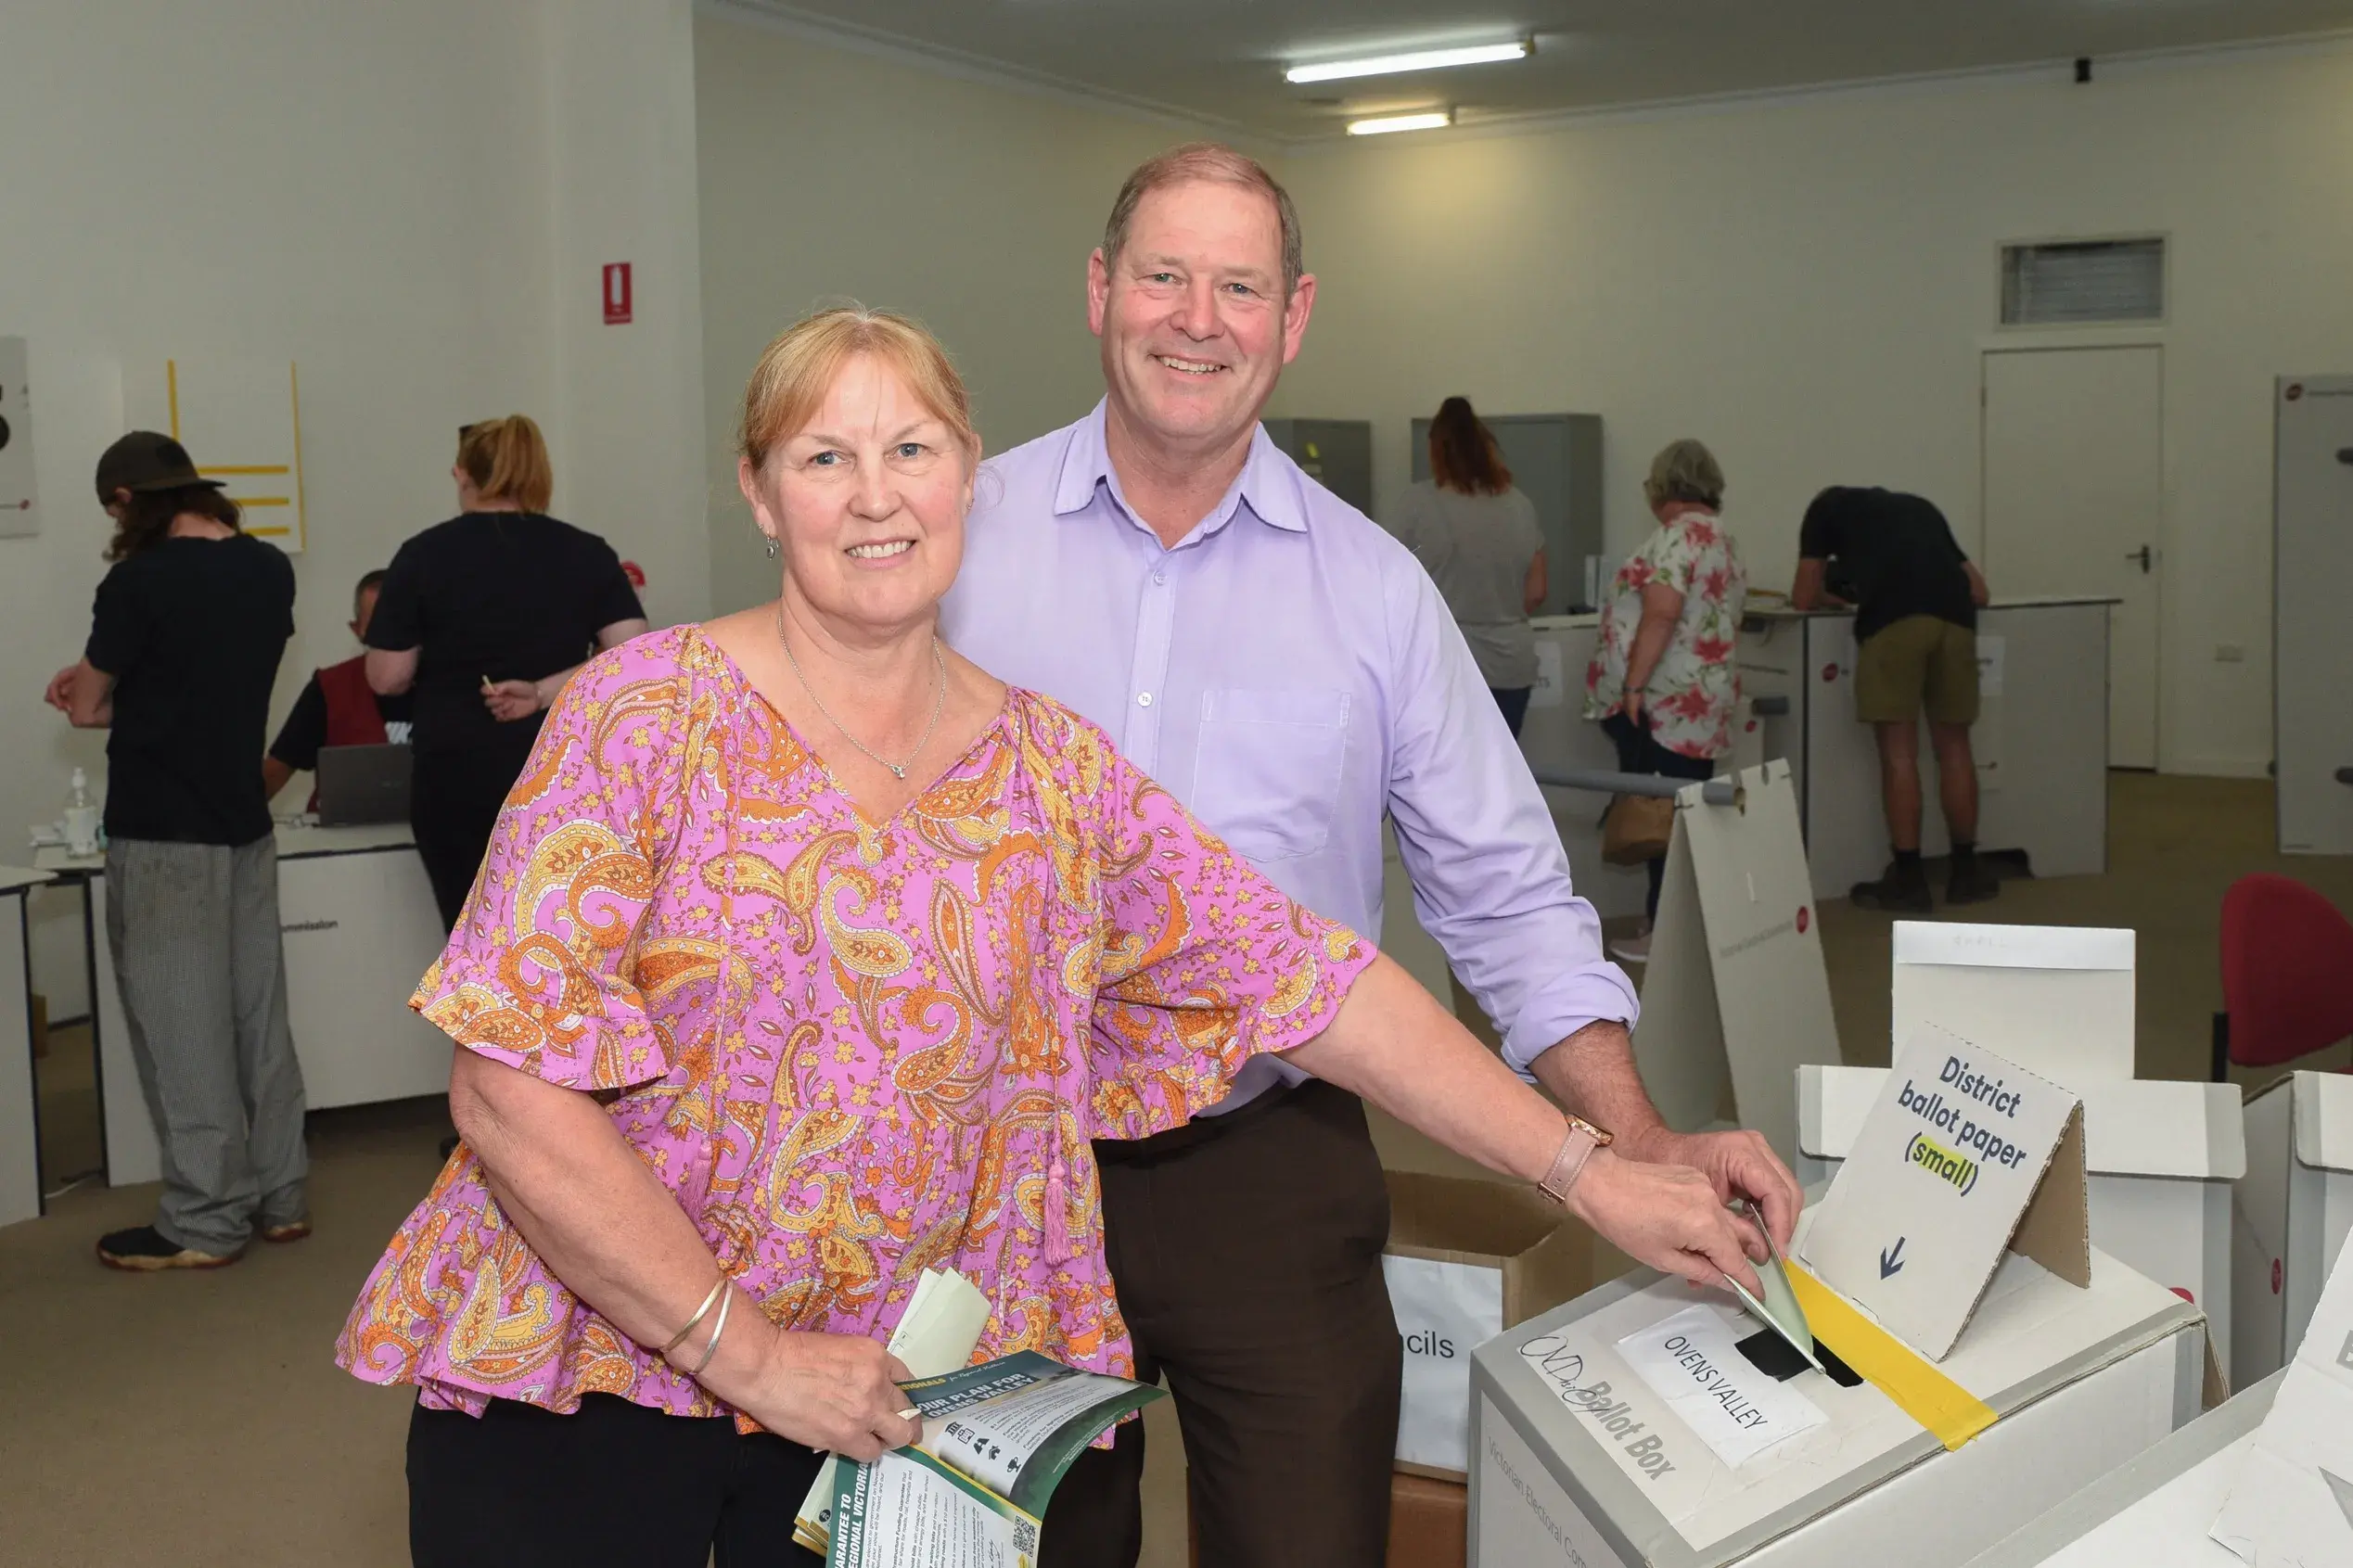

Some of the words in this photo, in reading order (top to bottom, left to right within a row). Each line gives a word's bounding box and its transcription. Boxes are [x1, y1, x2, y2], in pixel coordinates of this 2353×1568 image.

[1939, 1055, 2021, 1118] District
[1898, 1079, 1961, 1134] ballot
[1954, 1121, 2027, 1169] paper
[1905, 1131, 1979, 1197] (small)
[1400, 1330, 1454, 1358] cils
[916, 1398, 950, 1412] OUR
[949, 1384, 992, 1401] PLAN
[991, 1373, 1026, 1388] FOR
[927, 1398, 978, 1418] OVENS
[979, 1378, 1035, 1399] VALLEY
[1665, 1336, 1719, 1383] OVENS
[1707, 1378, 1768, 1429] VALLEY
[1576, 1381, 1645, 1442] Ballot
[1624, 1434, 1676, 1480] Box
[841, 1494, 851, 1510] TO
[852, 1462, 869, 1517] VICTORIA
[1489, 1436, 1524, 1496] Victorian
[1527, 1485, 1562, 1546] Electoral
